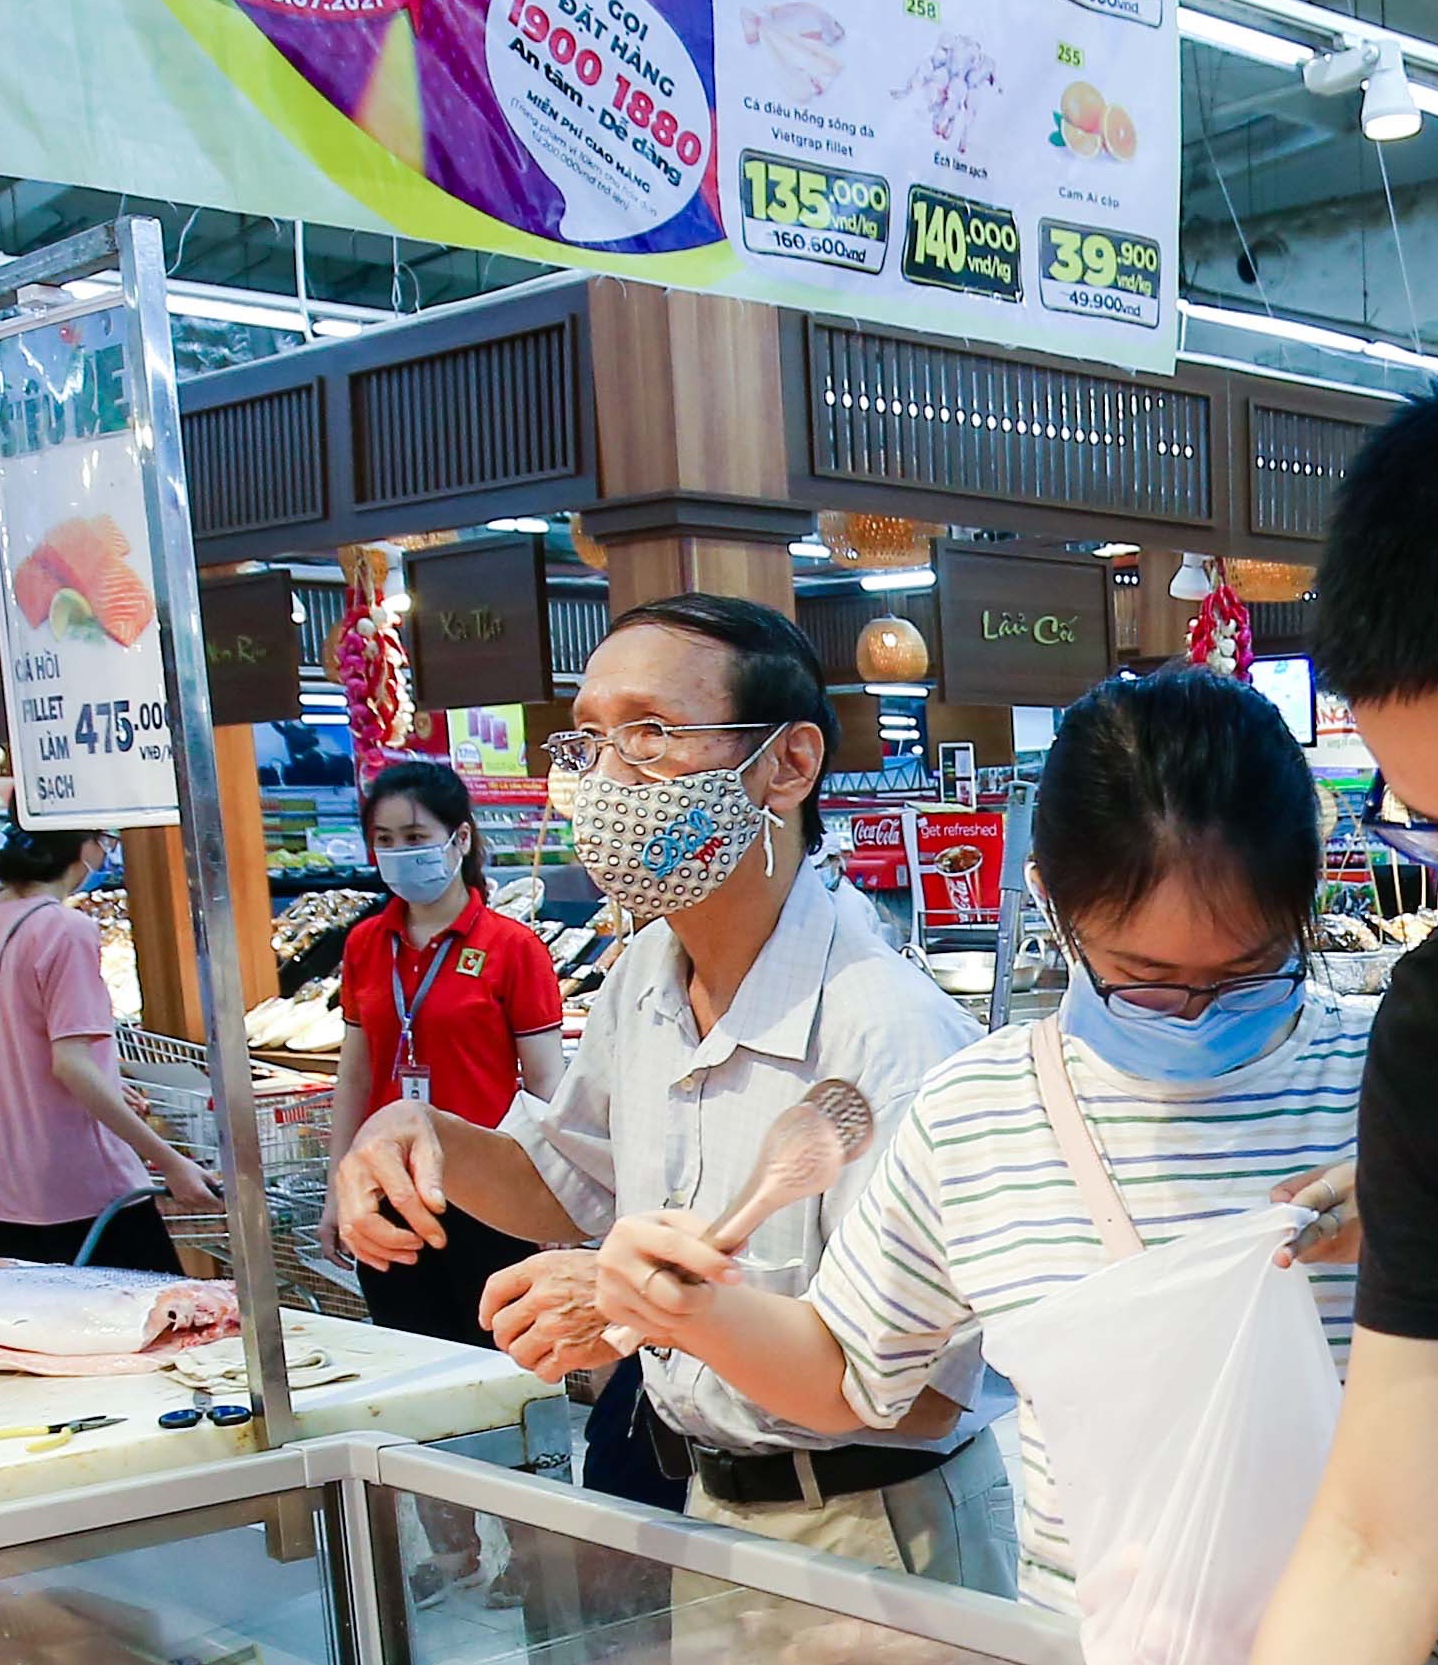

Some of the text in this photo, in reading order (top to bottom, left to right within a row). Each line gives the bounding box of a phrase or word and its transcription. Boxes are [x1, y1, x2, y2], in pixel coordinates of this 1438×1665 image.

[610, 35, 675, 97] HÀNG
[1057, 44, 1081, 66] 255
[508, 0, 702, 166] 1900 1880
[509, 37, 540, 70] An
[544, 63, 583, 107] tâm
[598, 108, 628, 141] Dễ
[632, 138, 682, 187] dàng
[826, 139, 853, 157] fillet
[585, 136, 613, 164] GIAO
[616, 162, 651, 193] HÀNG
[1059, 186, 1084, 202] Cam
[15, 649, 61, 683] CÁ HỒI
[23, 695, 63, 723] FILLET
[39, 731, 71, 761] LÀM
[37, 774, 75, 804] SẠCH
[921, 823, 998, 839] get refreshed
